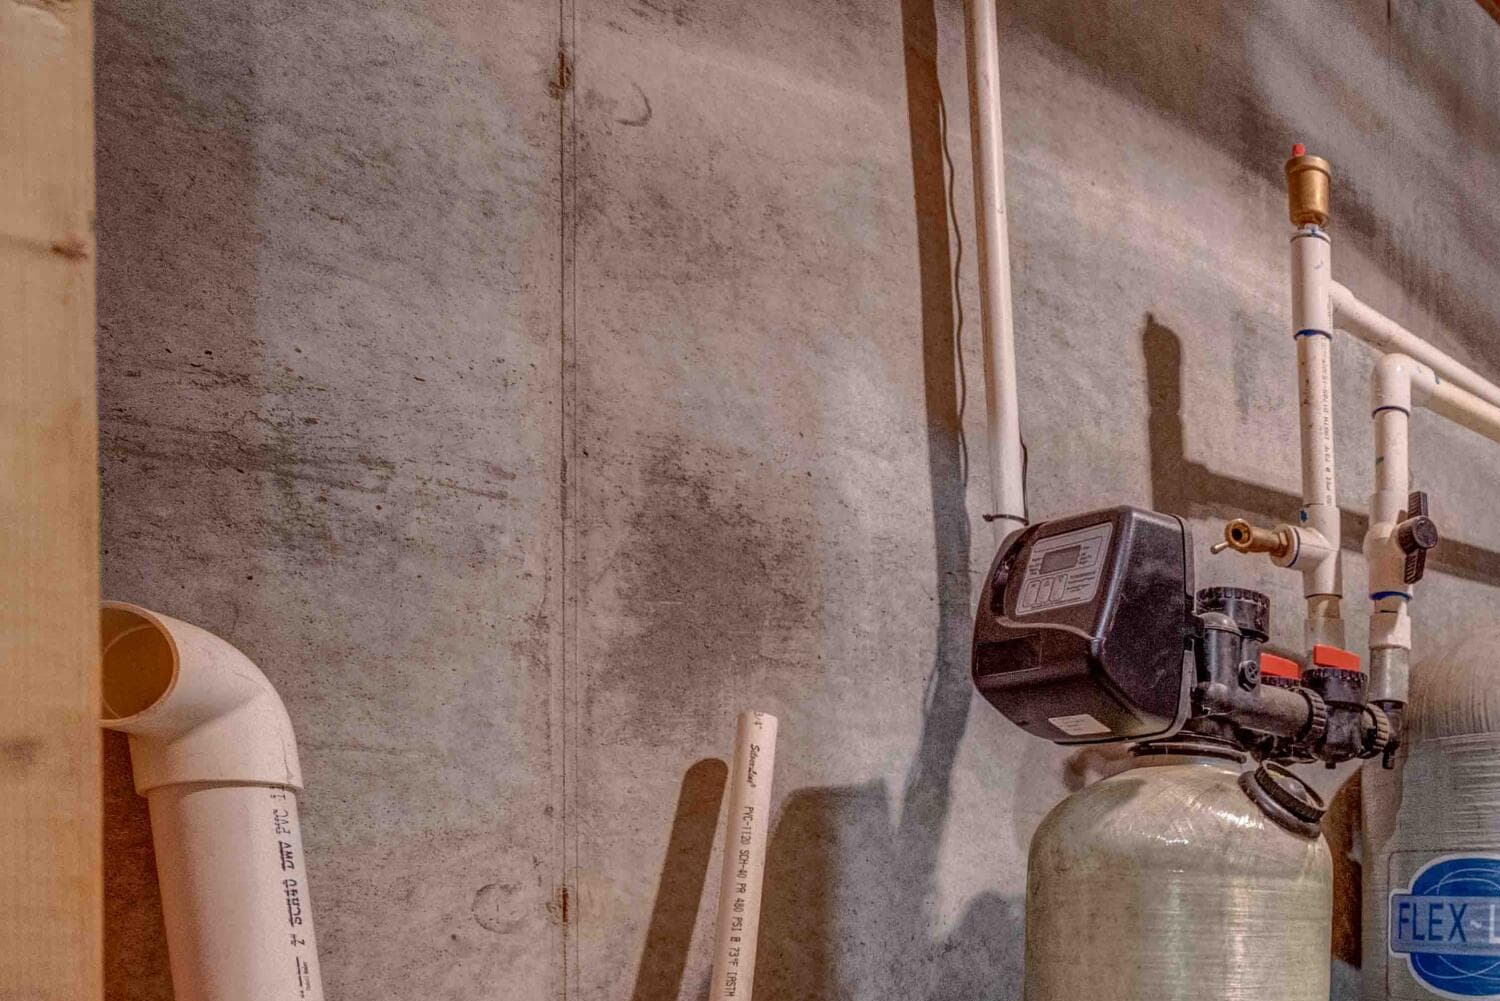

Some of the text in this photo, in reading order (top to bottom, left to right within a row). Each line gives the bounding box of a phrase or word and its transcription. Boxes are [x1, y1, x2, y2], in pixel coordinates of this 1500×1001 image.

[740, 806, 754, 845] PVC-1120
[278, 840, 295, 872] DWV
[737, 849, 750, 879] SCH-40
[736, 882, 747, 894] PR
[282, 879, 302, 928] SCH40
[733, 897, 744, 913] 480
[731, 916, 743, 932] PSI
